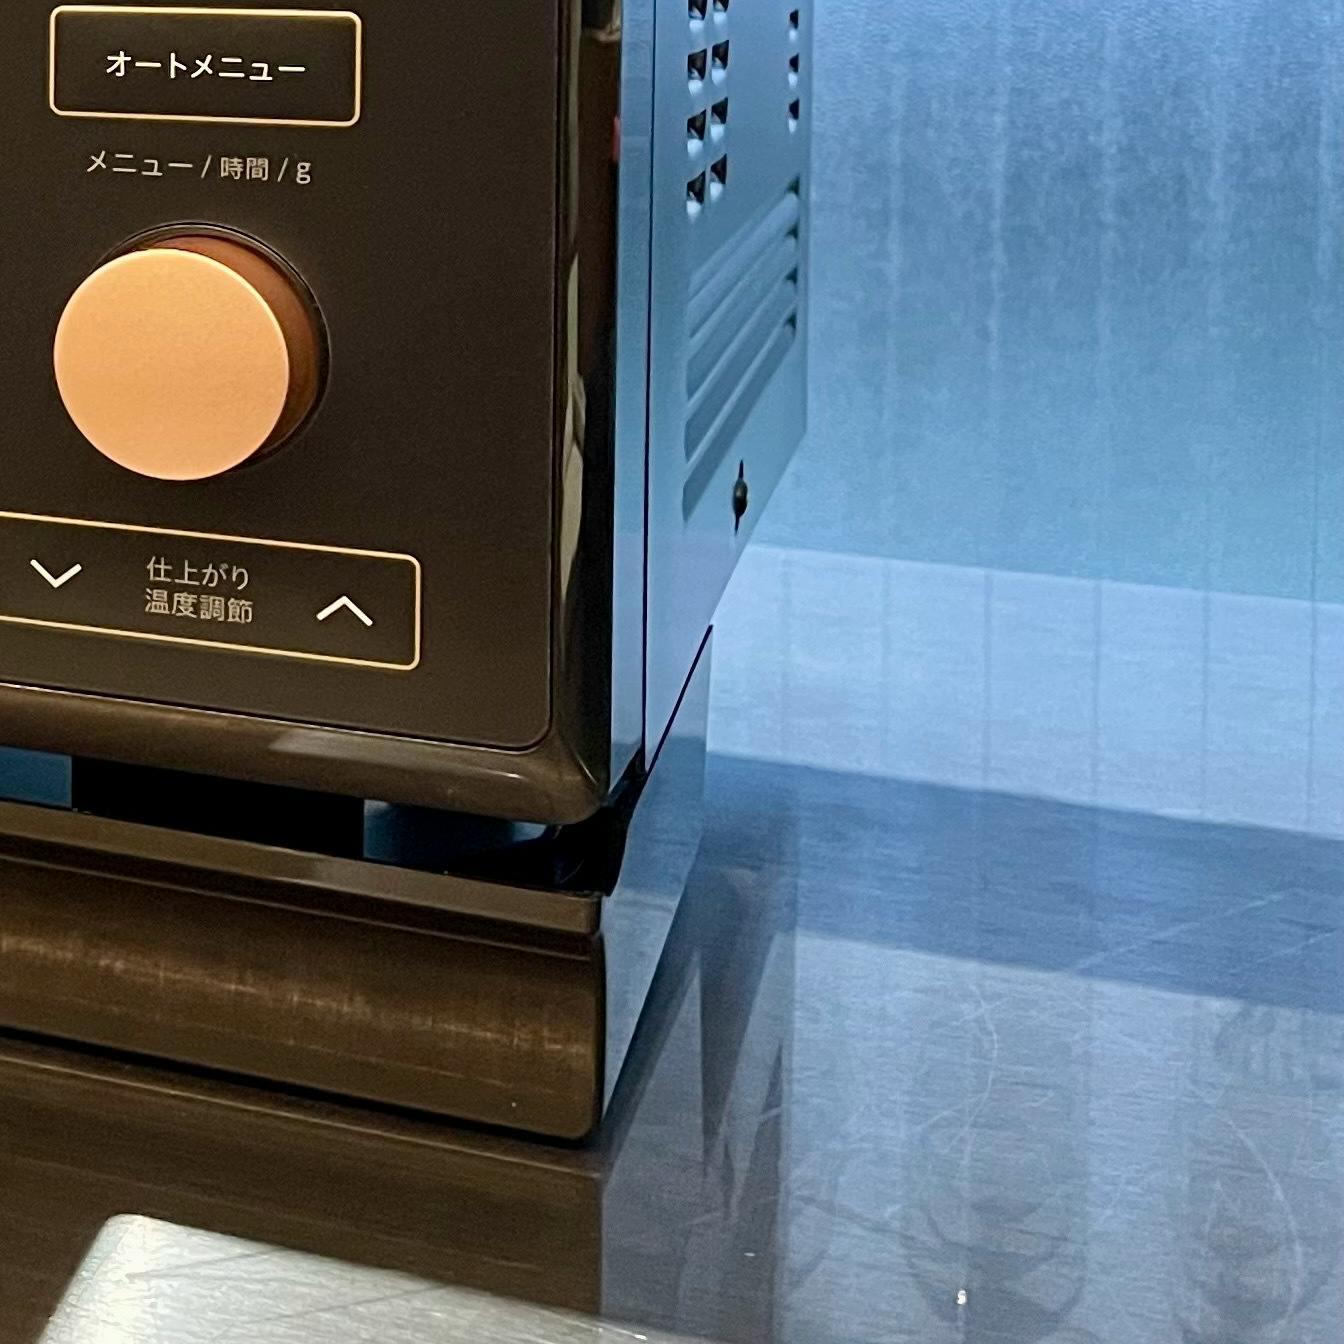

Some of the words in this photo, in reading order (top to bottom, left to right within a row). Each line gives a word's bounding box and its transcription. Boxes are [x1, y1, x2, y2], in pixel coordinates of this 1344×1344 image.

[106, 50, 306, 81] オートメニュー
[146, 555, 249, 591] 仕上がり
[144, 587, 253, 624] 温度調節
